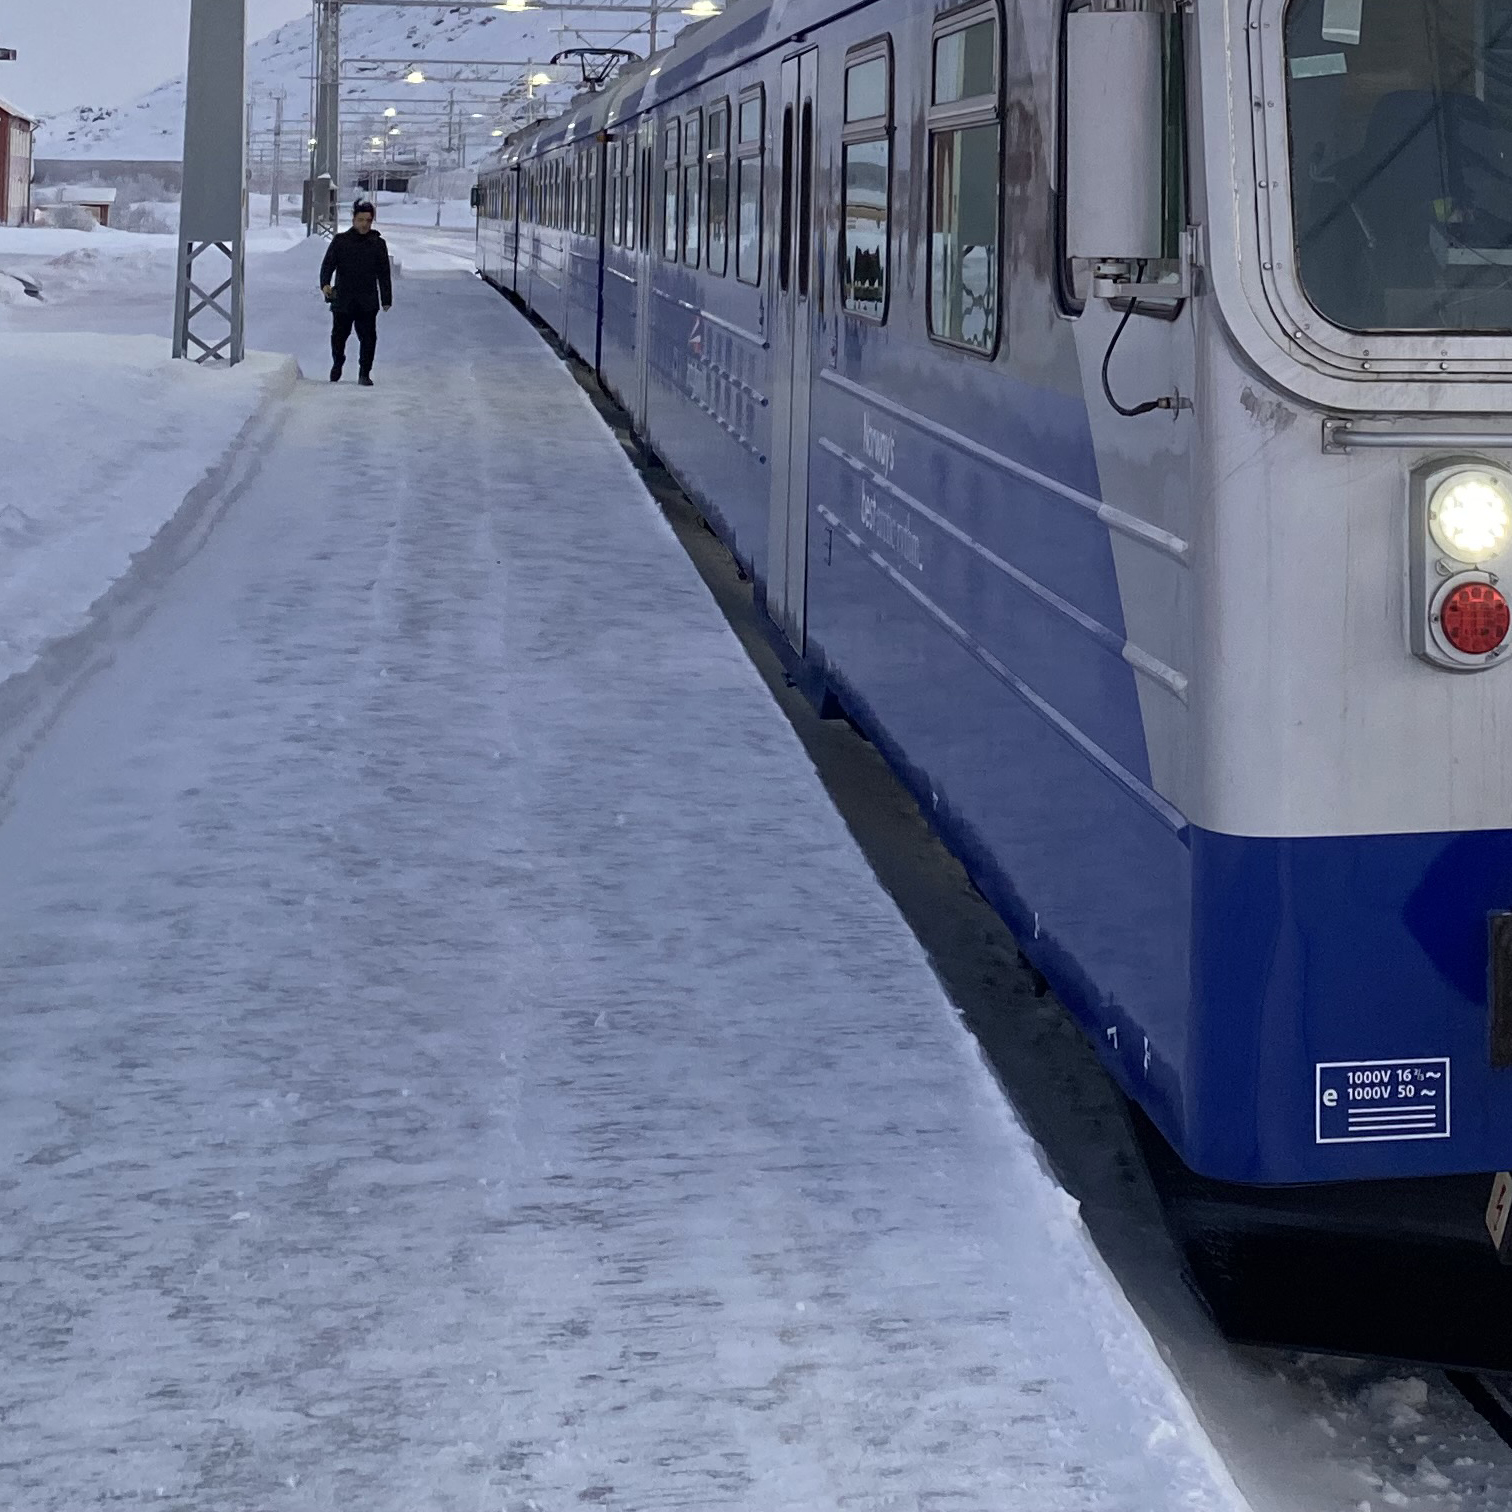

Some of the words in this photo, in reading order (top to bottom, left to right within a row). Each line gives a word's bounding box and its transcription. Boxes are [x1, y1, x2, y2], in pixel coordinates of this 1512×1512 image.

[1347, 1069, 1391, 1085] 1000V
[1322, 1088, 1338, 1107] e
[1347, 1085, 1391, 1101] 1000V
[1397, 1084, 1415, 1098] 50
